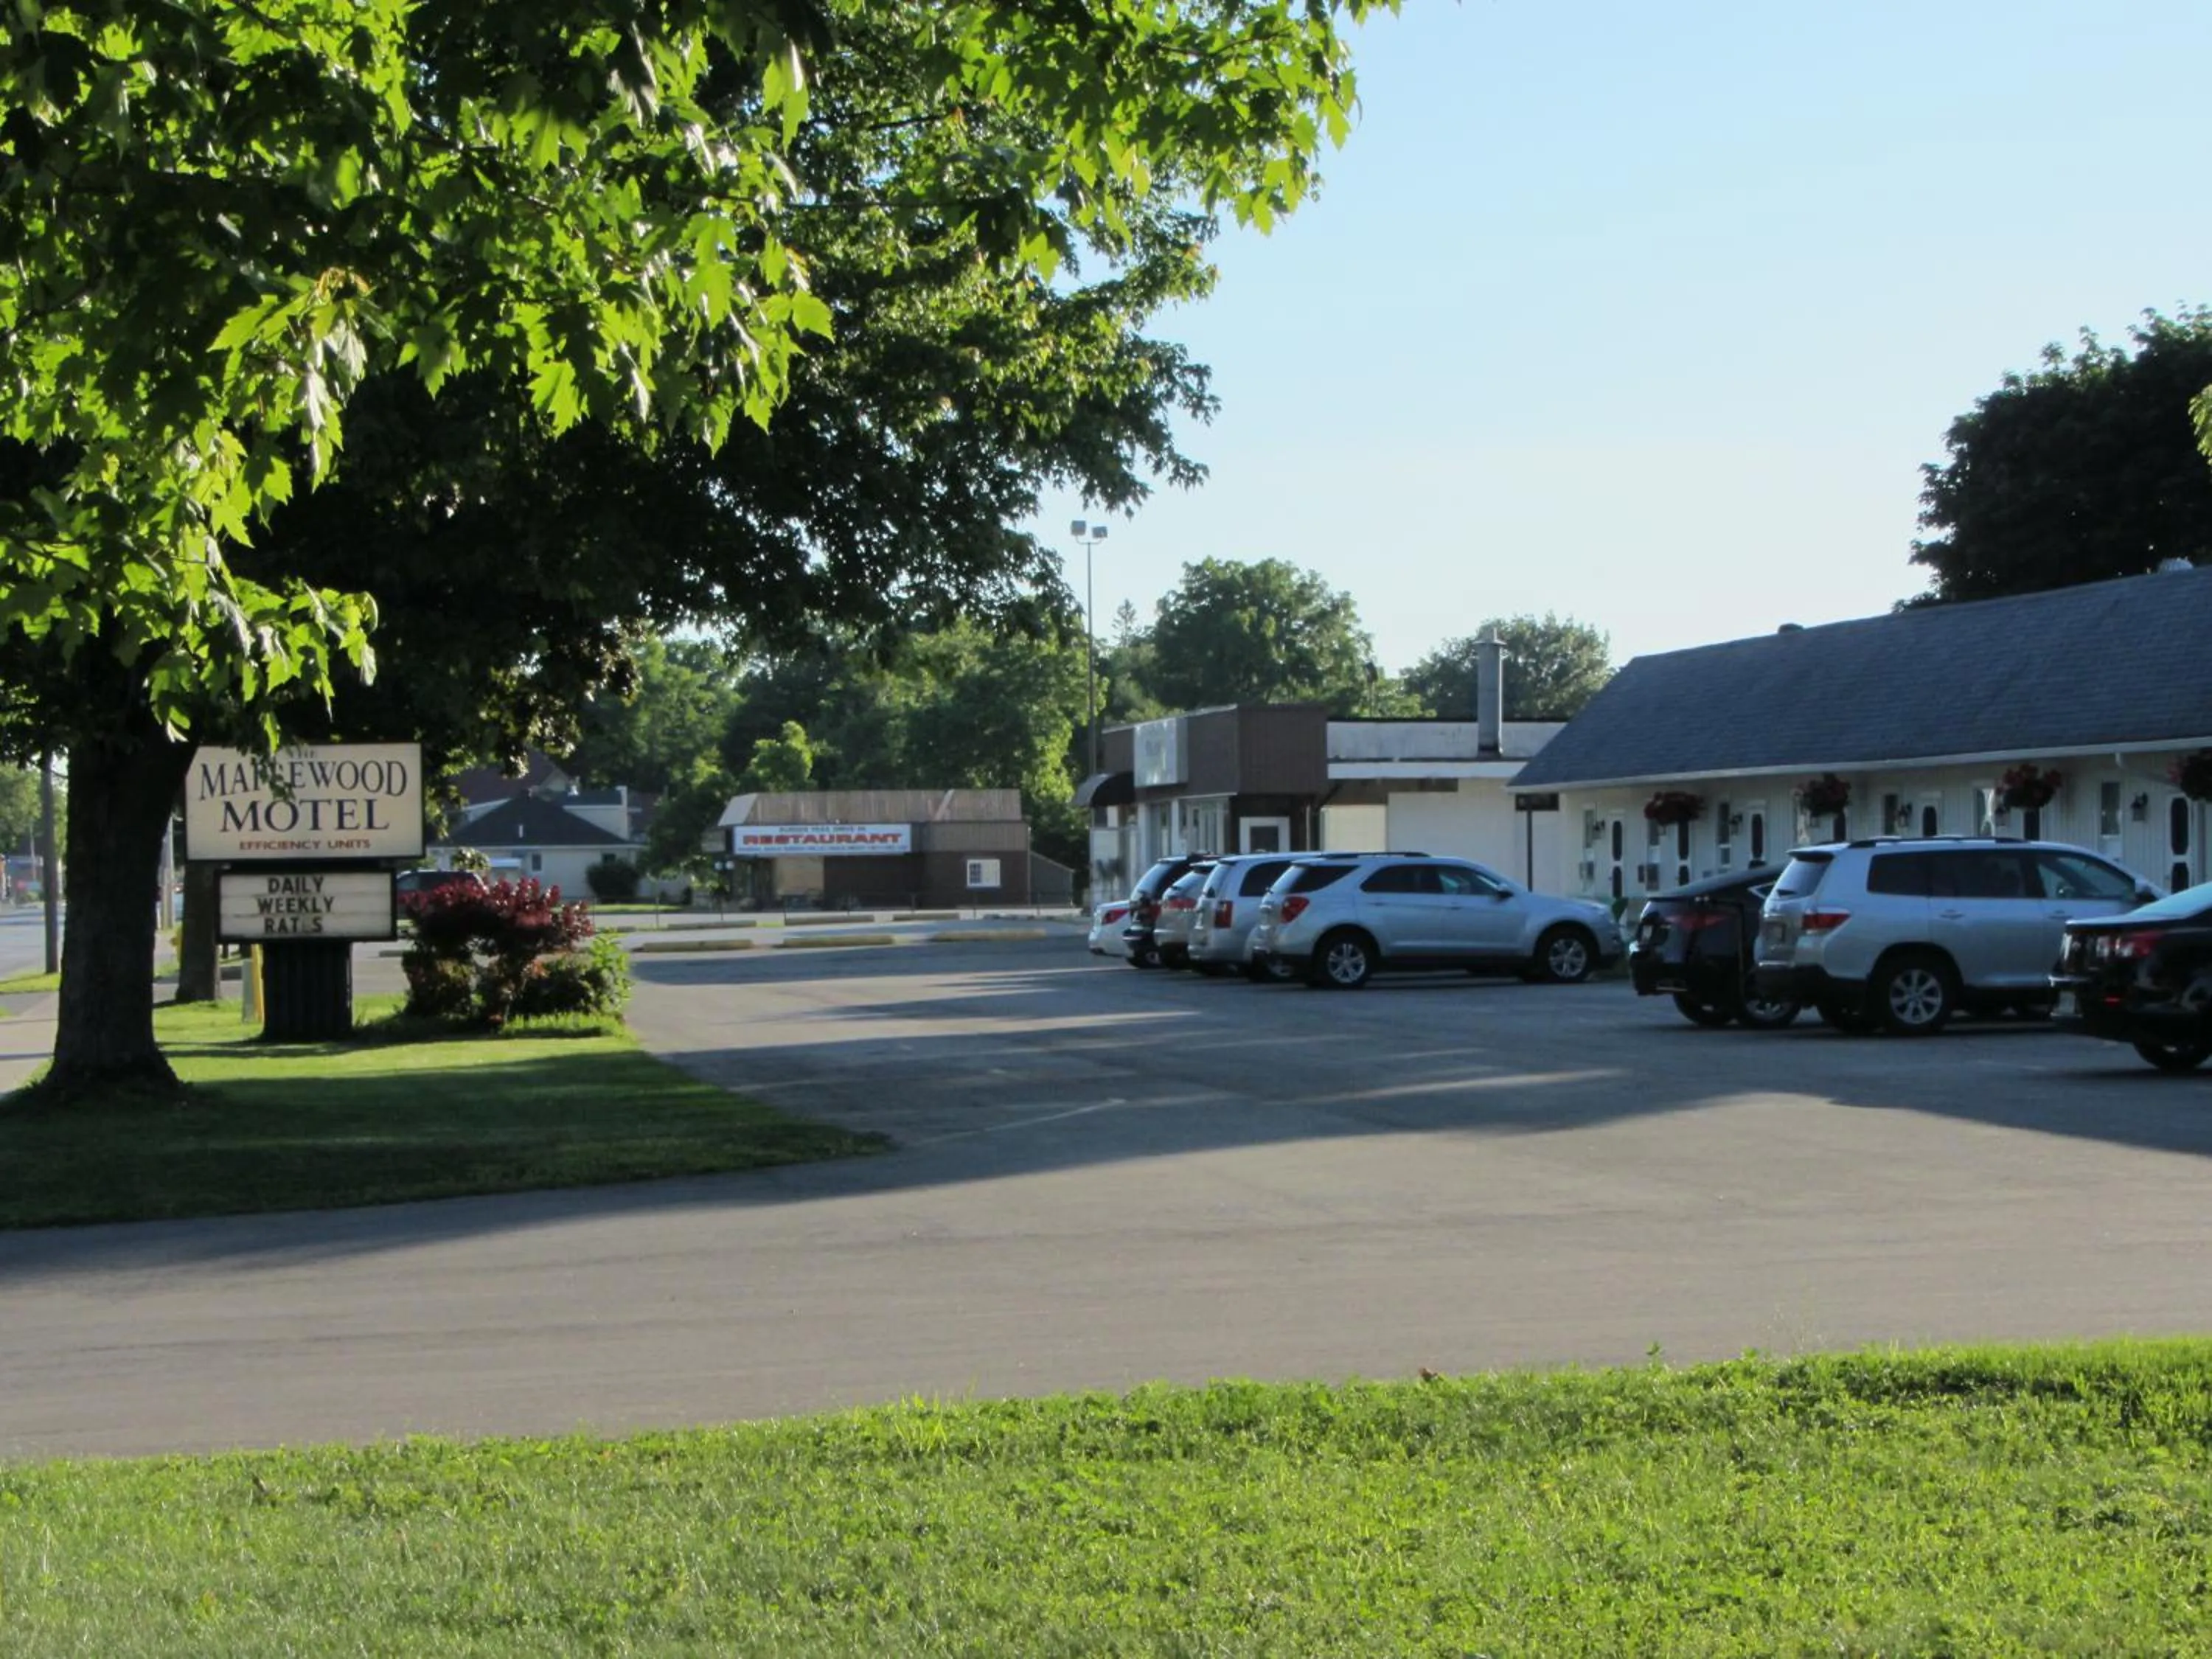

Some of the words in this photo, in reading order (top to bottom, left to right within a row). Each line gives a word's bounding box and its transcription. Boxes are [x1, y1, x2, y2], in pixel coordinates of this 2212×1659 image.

[198, 760, 407, 801] MAEWOOD
[219, 799, 390, 832] MOTEL
[239, 839, 321, 850] EFFICIENCY
[327, 838, 371, 849] UNITS
[742, 833, 902, 845] RESTAURANT
[268, 876, 324, 894] DAILY
[257, 896, 335, 914] WEEKLY
